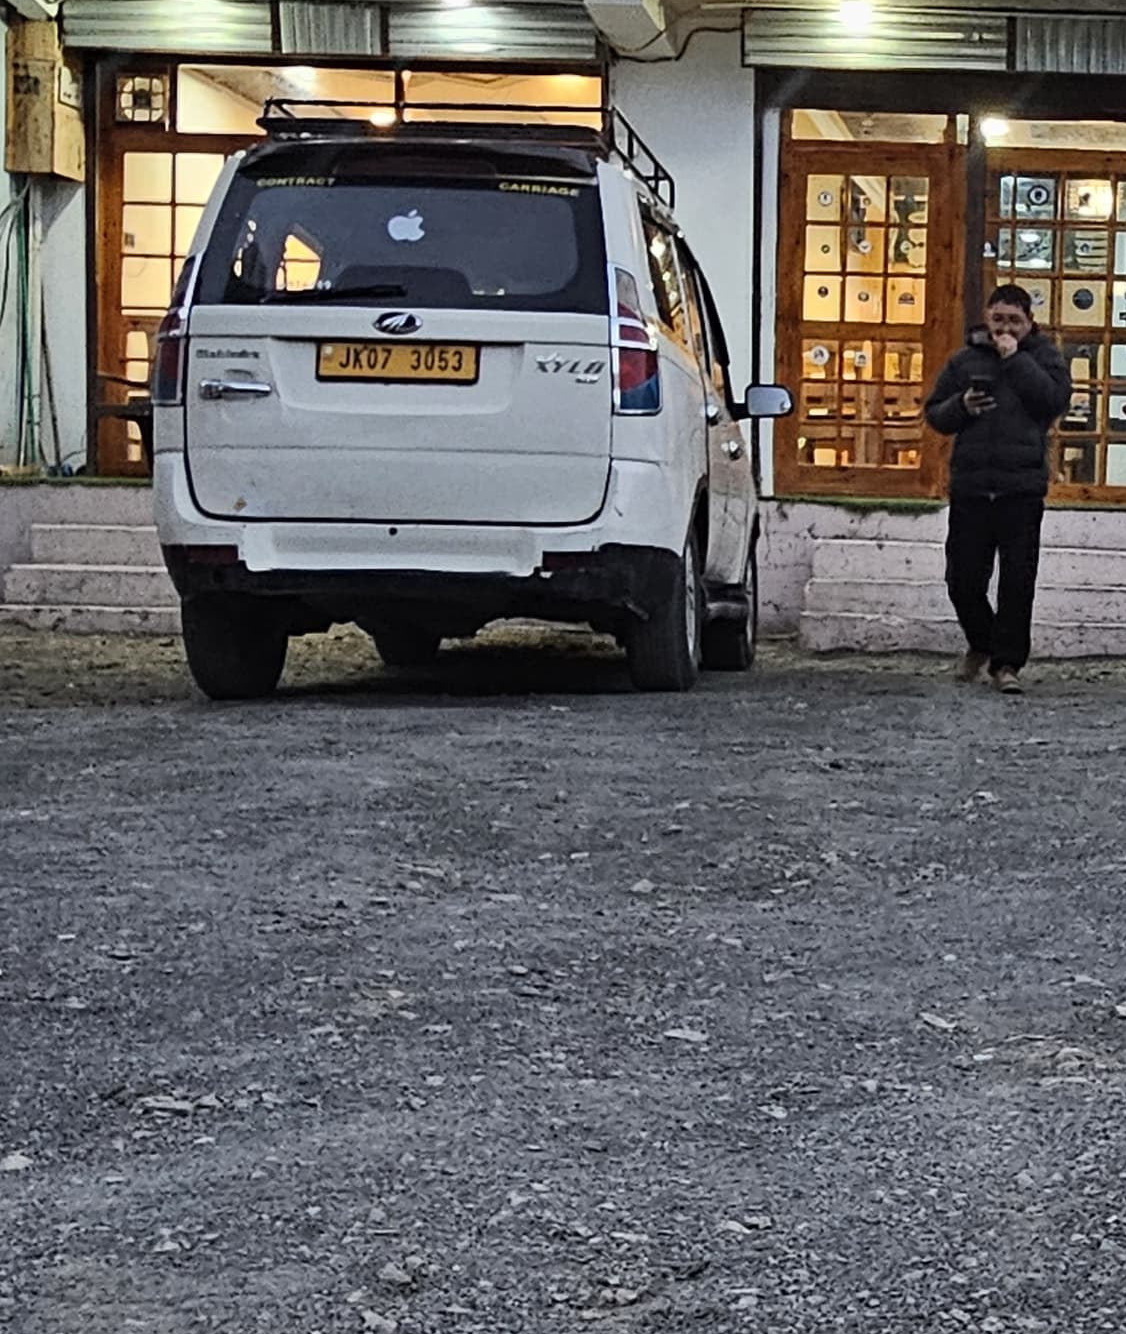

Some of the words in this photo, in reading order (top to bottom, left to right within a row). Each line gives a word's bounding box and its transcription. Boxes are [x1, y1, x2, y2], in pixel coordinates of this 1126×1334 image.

[257, 176, 335, 187] CONTRACT
[499, 182, 580, 196] CARRIAGE
[339, 347, 392, 369] JK07
[410, 348, 464, 372] 3053
[536, 354, 606, 374] XYLO
